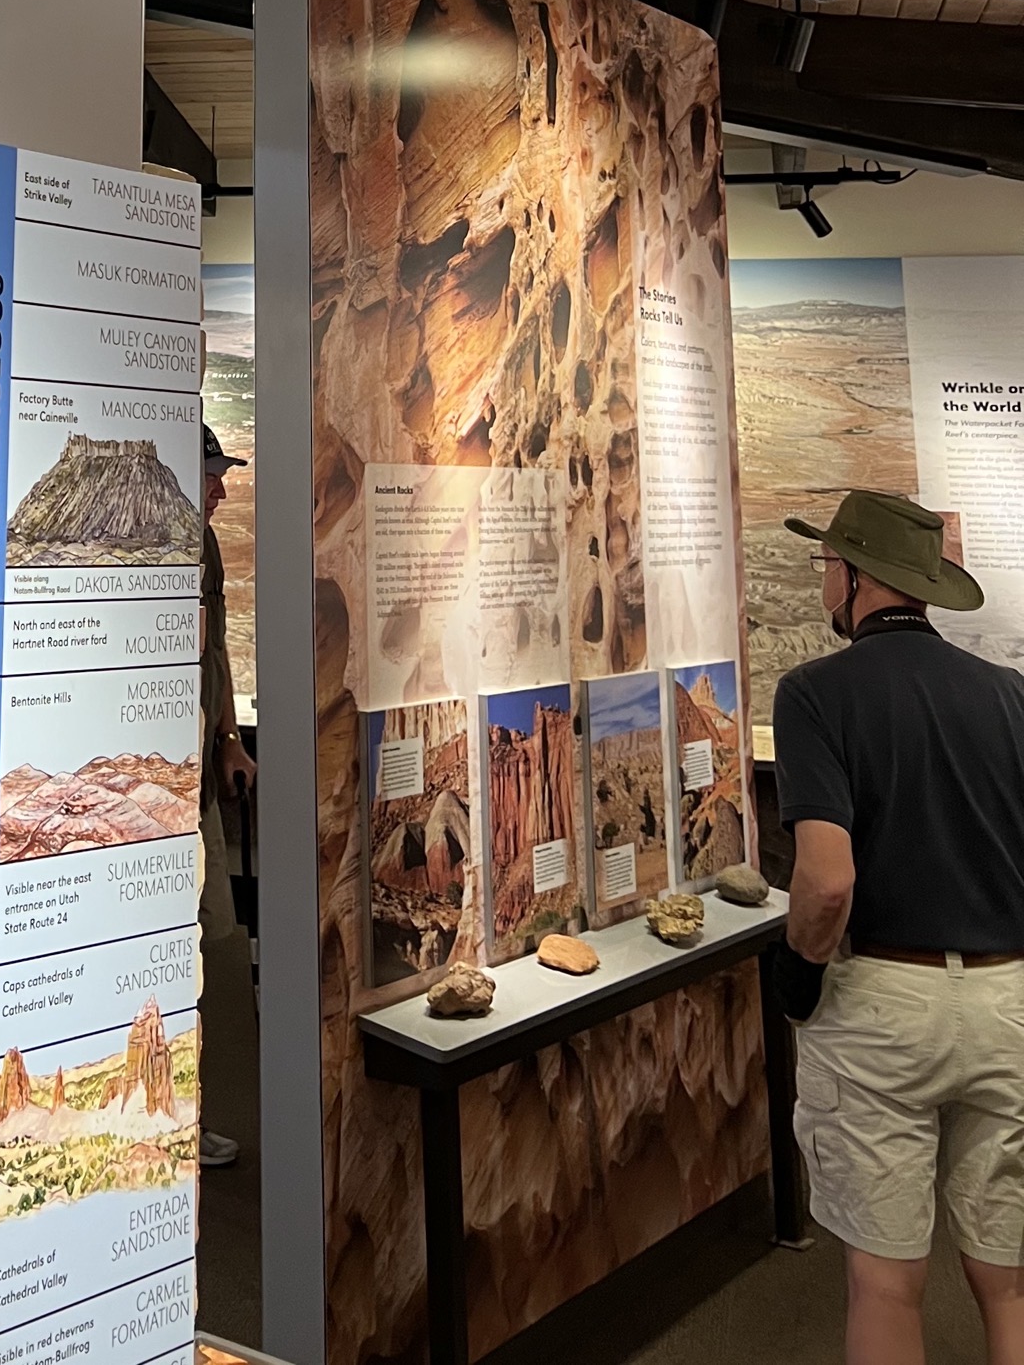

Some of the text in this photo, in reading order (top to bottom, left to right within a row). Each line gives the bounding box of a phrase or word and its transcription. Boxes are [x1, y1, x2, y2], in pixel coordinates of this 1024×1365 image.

[25, 172, 70, 189] East side of
[24, 189, 72, 208] Strike Valley
[92, 178, 196, 212] TARANTULA MESA
[126, 204, 196, 231] SANDSTONE
[77, 260, 196, 292] MASUK FORMATION
[639, 286, 676, 304] The Stories
[640, 307, 682, 326] Rocks Tell Us
[100, 328, 196, 353] MULEY CANYON
[125, 350, 196, 373] SANDSTONE
[942, 382, 1003, 393] Wrinkle
[19, 392, 73, 408] Factory Butte
[943, 401, 1021, 412] the World
[19, 411, 78, 424] near Caineville
[102, 401, 195, 423] MANCOS SHALE
[375, 486, 413, 494] Ancient Rocks
[76, 574, 197, 593] DAKOTA SANDSTONE
[13, 617, 101, 631] North and east of the
[156, 613, 194, 631] CEDAR
[13, 634, 108, 649] Hartnet Road river ford
[126, 634, 195, 654] MOUNTAIN
[11, 692, 71, 707] Bentonite Hills
[128, 678, 194, 700] MORRISON
[120, 700, 194, 723] FORMATION
[108, 850, 194, 882] SUMMERVILLE
[5, 872, 92, 896] Visible near the east
[119, 872, 195, 902] FORMATION
[4, 892, 79, 915] entrance on Utah
[4, 913, 68, 935] State Route 24
[150, 937, 193, 963] CURTIS
[3, 964, 85, 994] Caps cathedrals of
[116, 960, 192, 994] SANDSTONE
[2, 992, 74, 1018] Cathedral Valley
[130, 1193, 190, 1231] ENTRADA
[112, 1215, 190, 1261] SANDSTONE
[47, 1249, 56, 1263] of
[42, 1273, 68, 1293] Valley
[136, 1275, 189, 1312] CARMEL
[111, 1299, 190, 1349] FORMATION
[26, 1341, 34, 1354] in
[37, 1333, 52, 1350] red
[55, 1319, 94, 1342] chevrons
[22, 1341, 90, 1365] tom-Bullfrog
